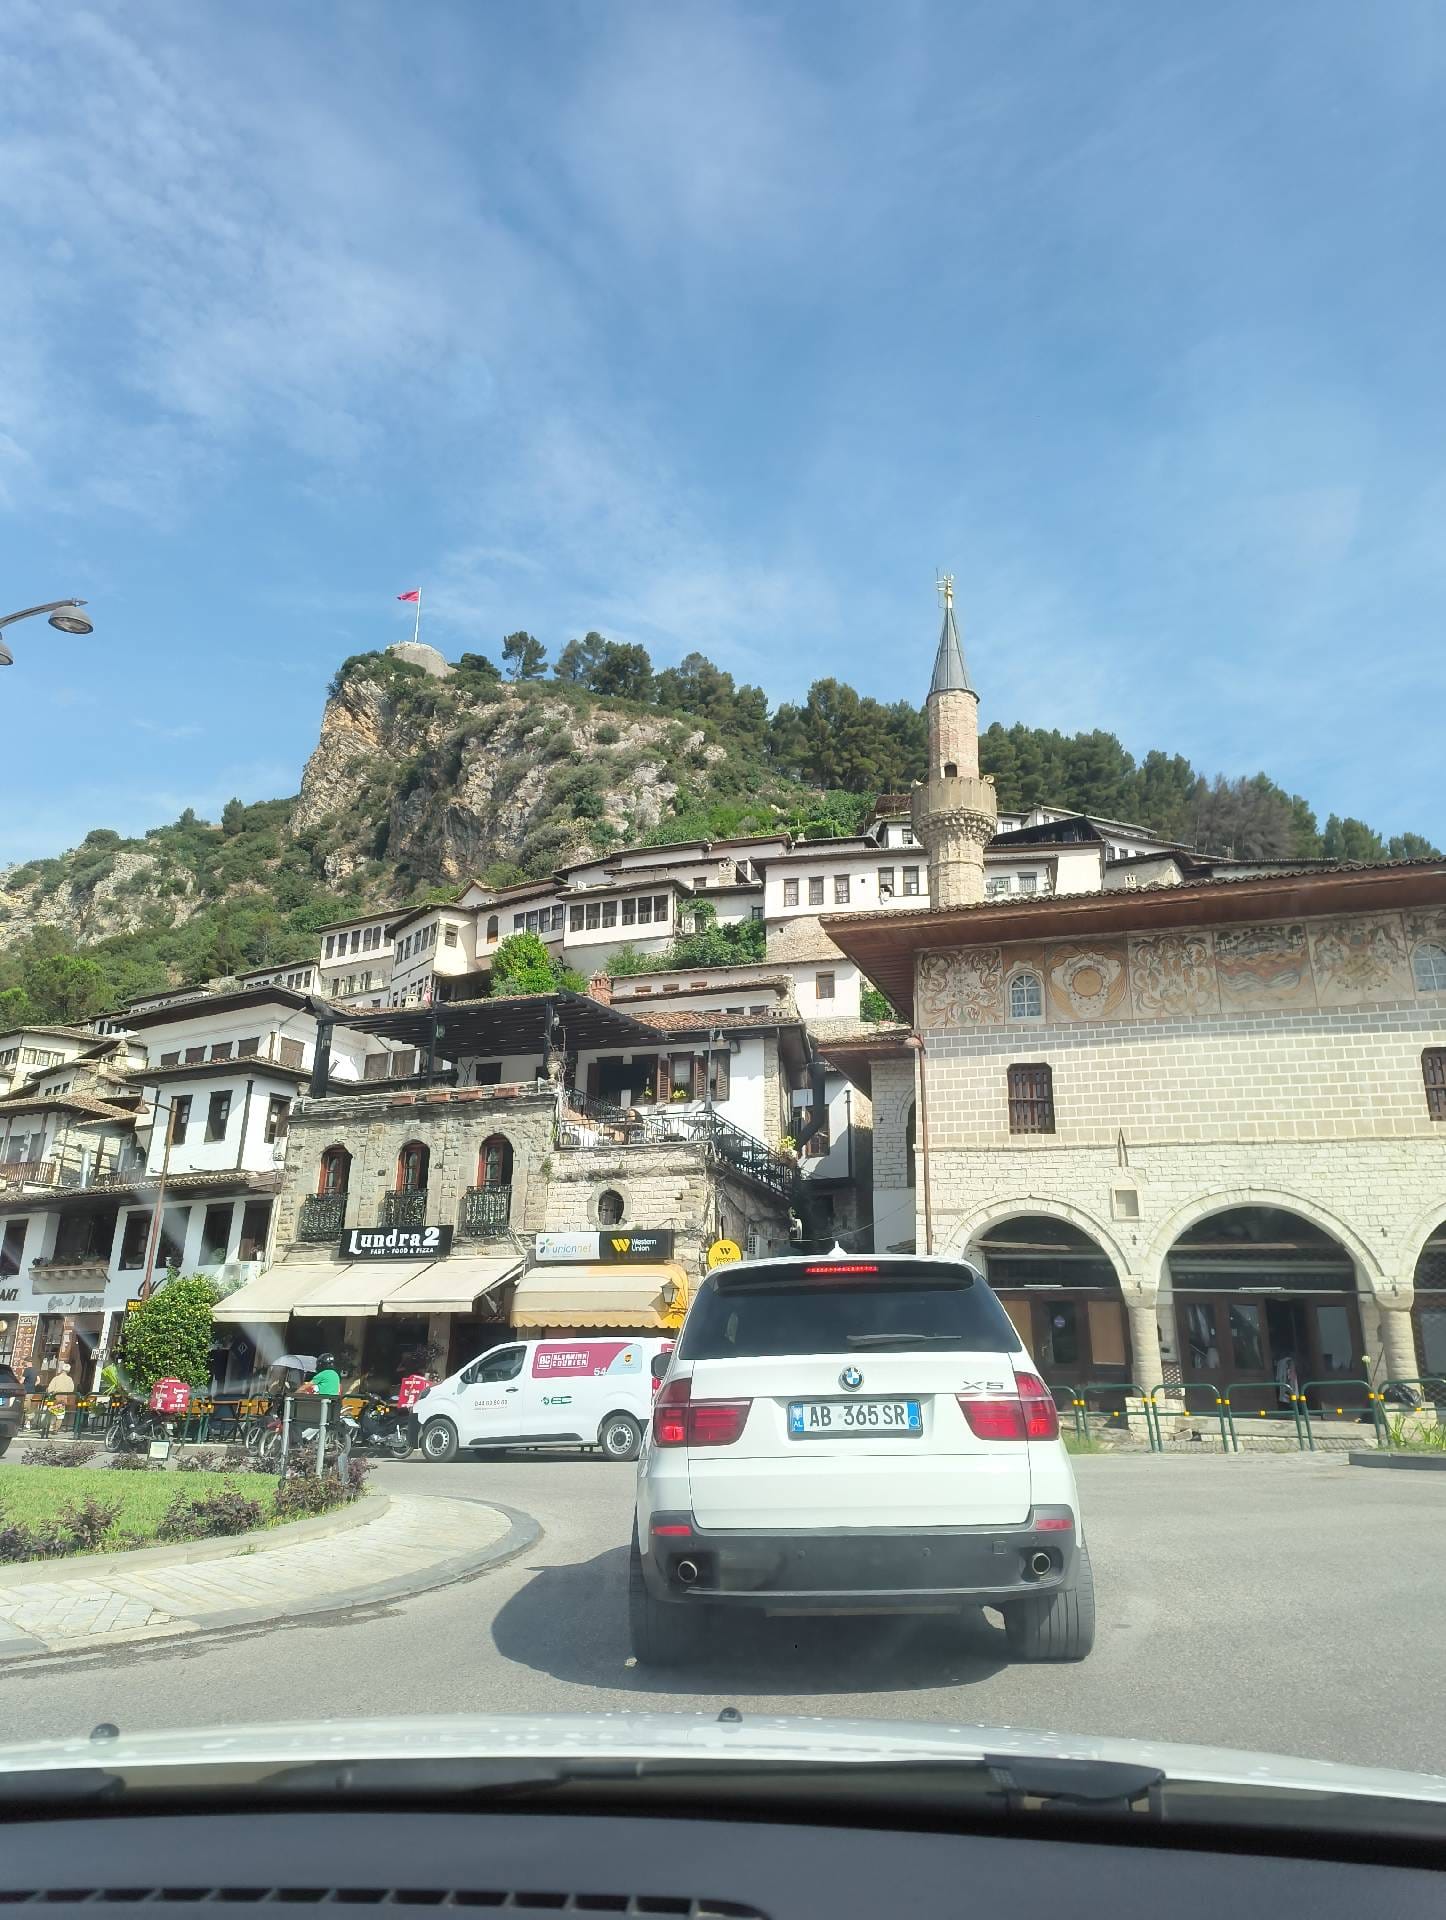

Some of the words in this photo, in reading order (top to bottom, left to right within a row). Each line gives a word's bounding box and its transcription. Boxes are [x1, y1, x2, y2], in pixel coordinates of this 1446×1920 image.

[90, 1348, 110, 1361] OPEN
[552, 1359, 587, 1367] COURIER
[961, 1380, 1004, 1391] X5
[809, 1405, 832, 1427] AB
[843, 1405, 879, 1426] 365
[883, 1404, 906, 1425] SR
